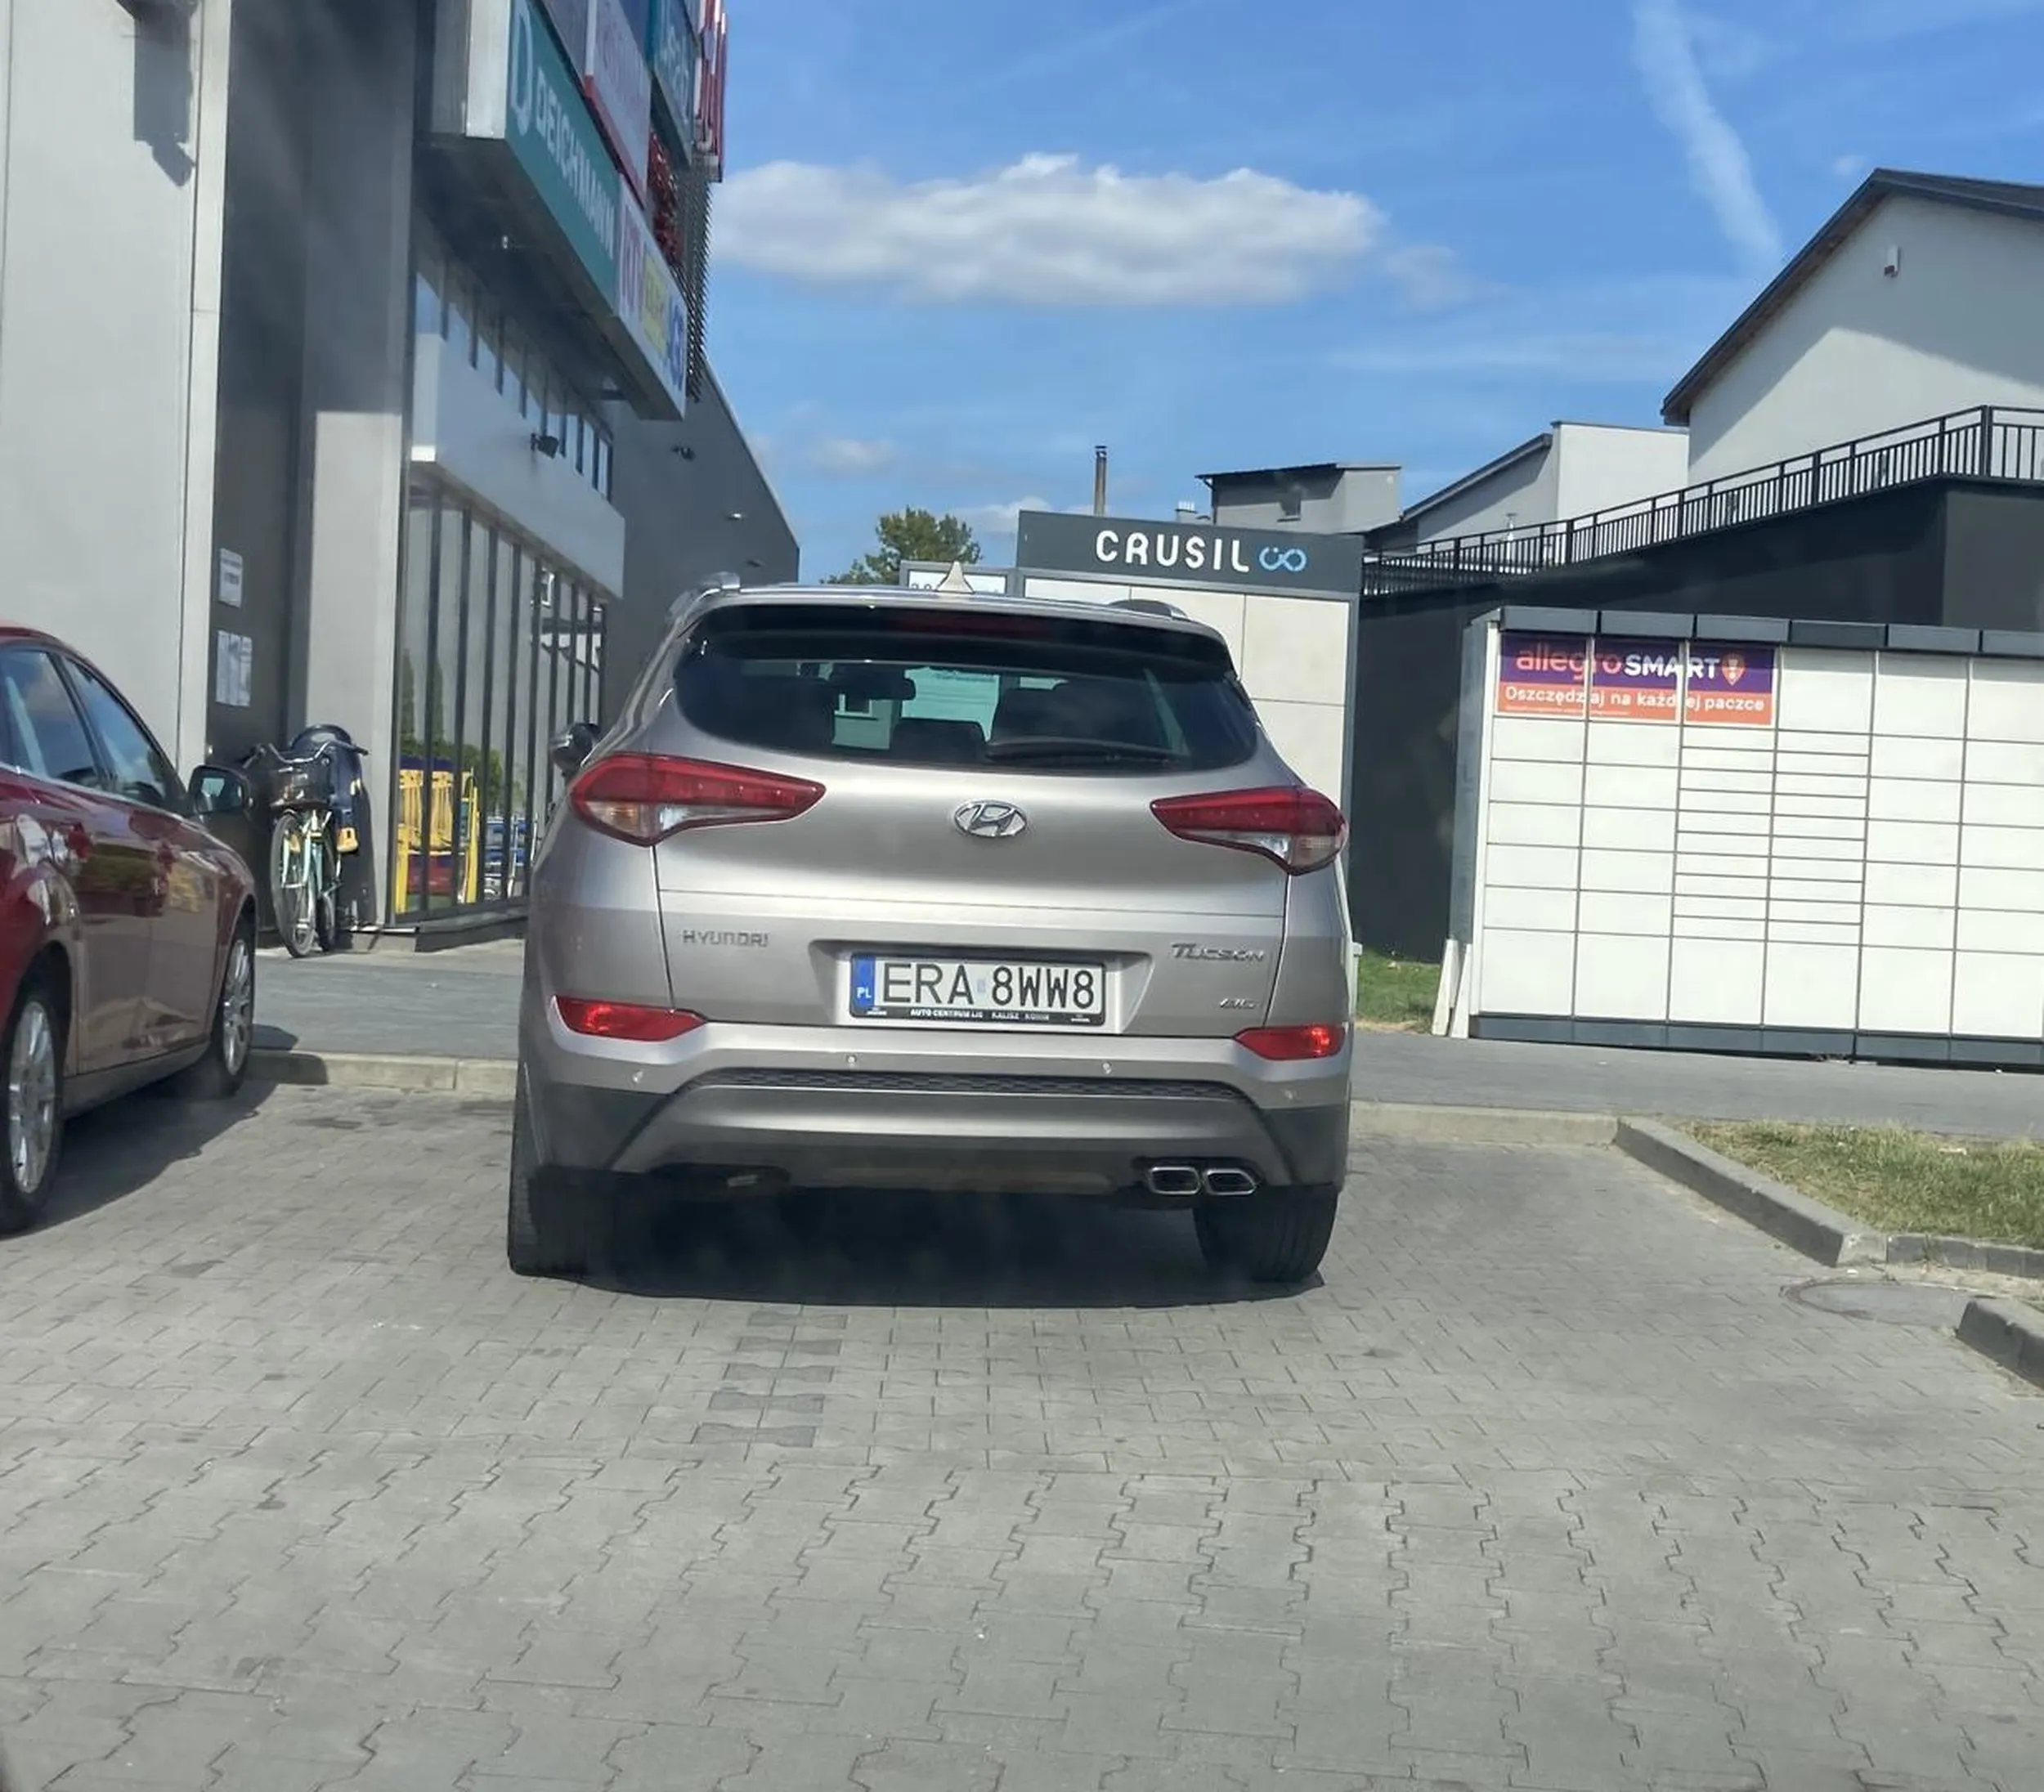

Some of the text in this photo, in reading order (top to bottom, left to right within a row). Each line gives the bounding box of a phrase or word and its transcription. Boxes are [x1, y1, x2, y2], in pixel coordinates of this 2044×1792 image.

[536, 67, 614, 260] DEICHMANN
[1516, 643, 1720, 680] allegro SMART
[1611, 692, 1632, 706] na
[1637, 692, 1701, 710] każdej
[1705, 697, 1764, 710] paczce
[683, 930, 769, 948] HYUNDAI
[857, 987, 872, 999] PL
[883, 962, 1095, 1009] ERA 8WW8
